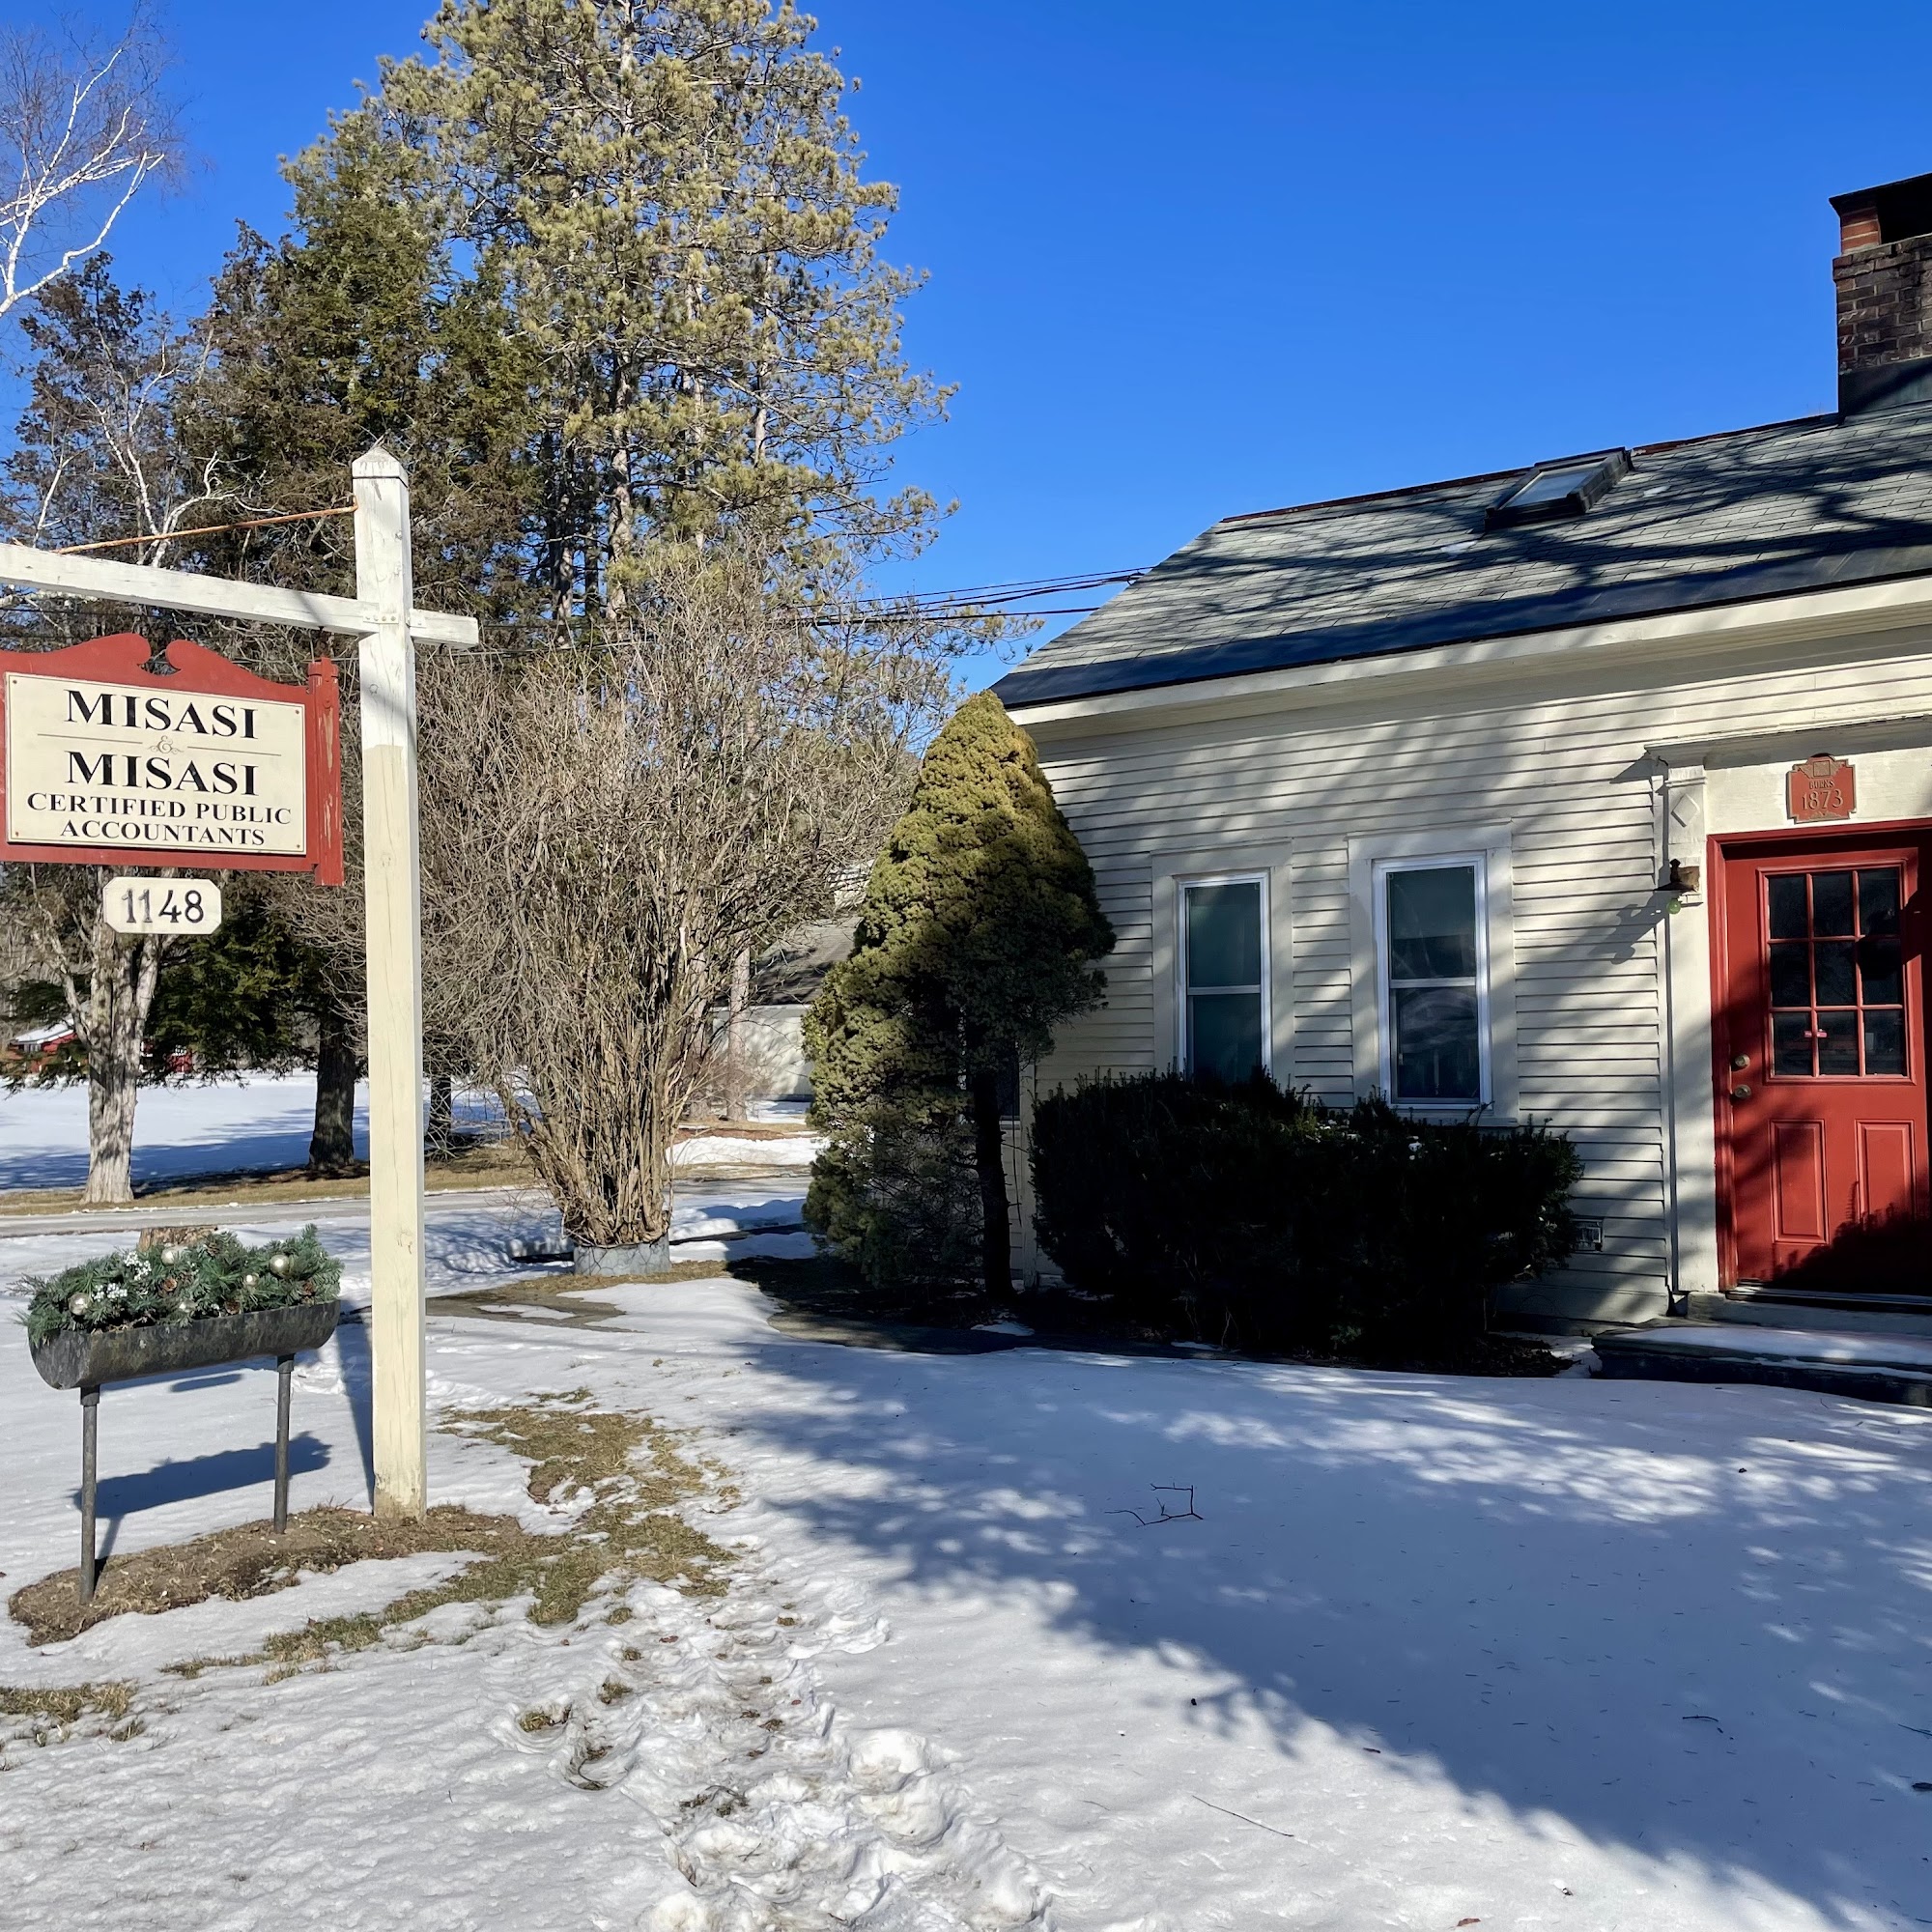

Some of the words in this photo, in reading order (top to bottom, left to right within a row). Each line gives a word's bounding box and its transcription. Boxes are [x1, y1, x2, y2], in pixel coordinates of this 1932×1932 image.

[65, 689, 259, 739] MISASI
[65, 751, 260, 797] MISASI
[27, 792, 186, 818] CERTIFIED
[196, 803, 292, 825] PUBLIC
[1803, 788, 1844, 810] 1873
[60, 819, 266, 846] ACCOUNTANTS
[122, 888, 205, 923] 1148
